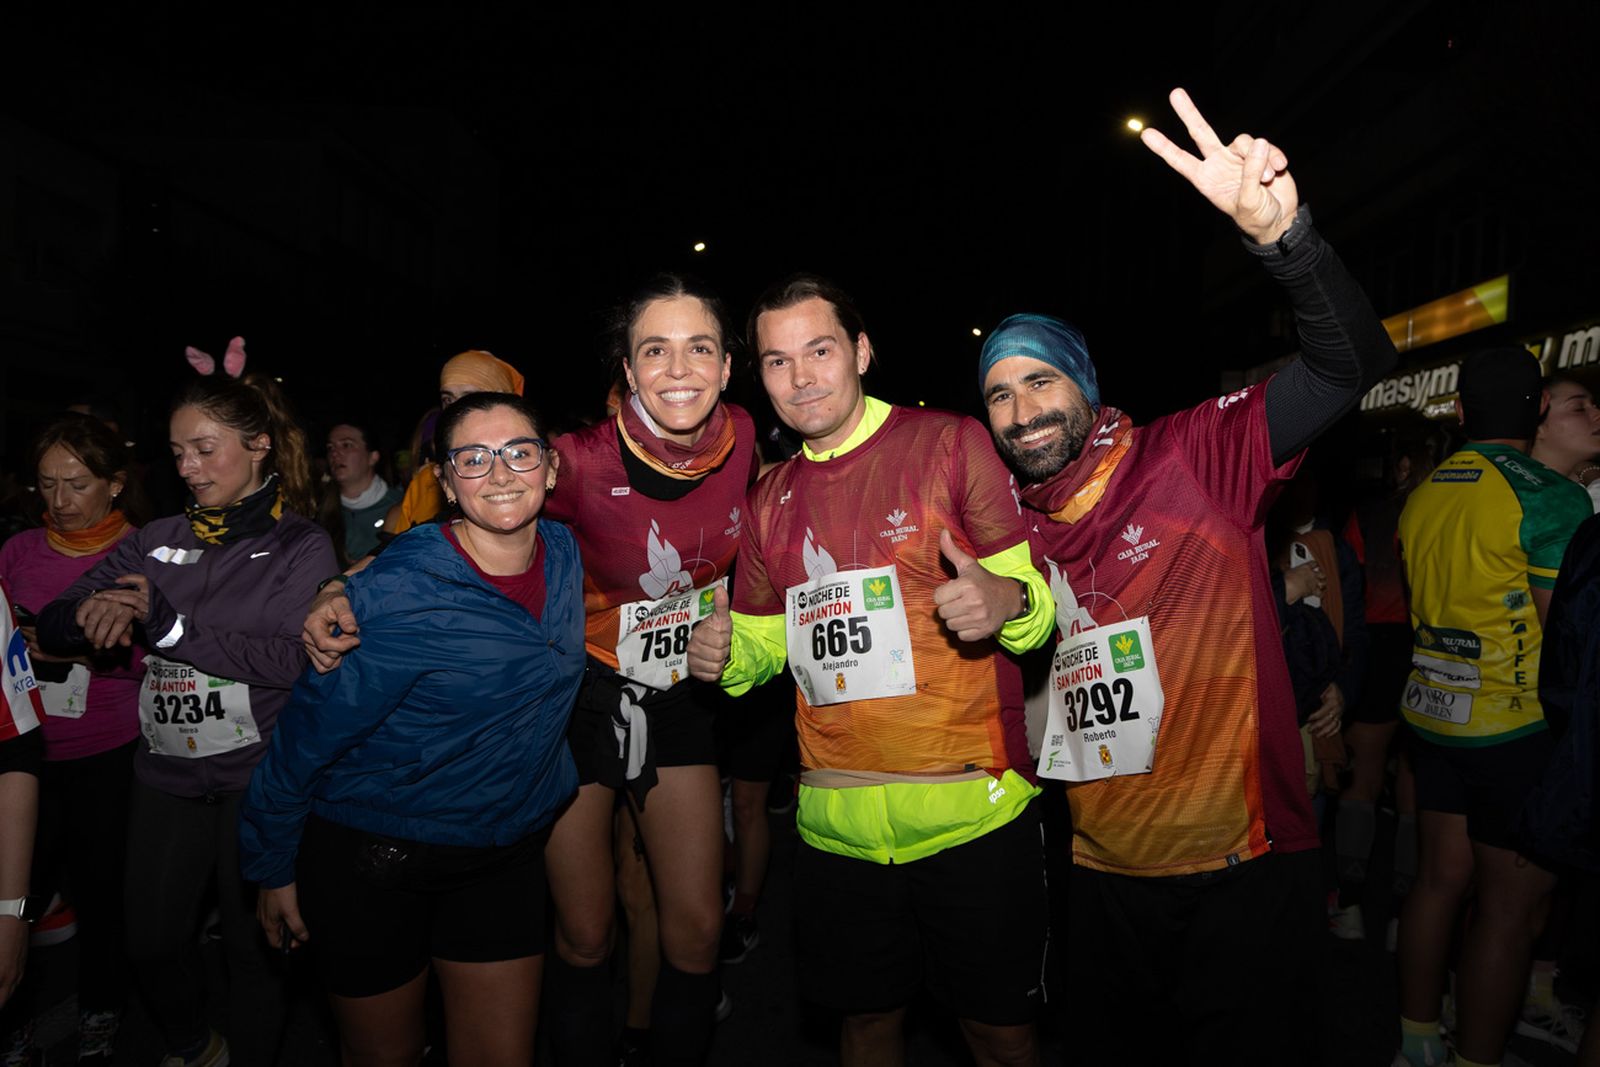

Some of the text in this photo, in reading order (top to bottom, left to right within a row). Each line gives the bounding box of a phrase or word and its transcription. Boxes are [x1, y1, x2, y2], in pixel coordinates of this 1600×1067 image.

[1117, 549, 1135, 560] CAJA
[650, 601, 678, 616] NOCHE
[681, 599, 691, 609] DE
[809, 590, 833, 607] NOCHE
[836, 586, 850, 598] DE
[799, 610, 814, 626] SAN
[816, 599, 851, 621] ANTÓN
[640, 620, 702, 662] 758
[812, 616, 872, 660] 665
[822, 660, 858, 671] Alejandro
[1062, 653, 1083, 669] NOCHE
[1085, 647, 1099, 662] DE
[152, 668, 195, 679] OCHE DE
[1057, 663, 1103, 691] SAN ANTÓN
[153, 691, 225, 724] 3234
[1064, 678, 1140, 732] 3292
[1084, 729, 1116, 743] Roberto
